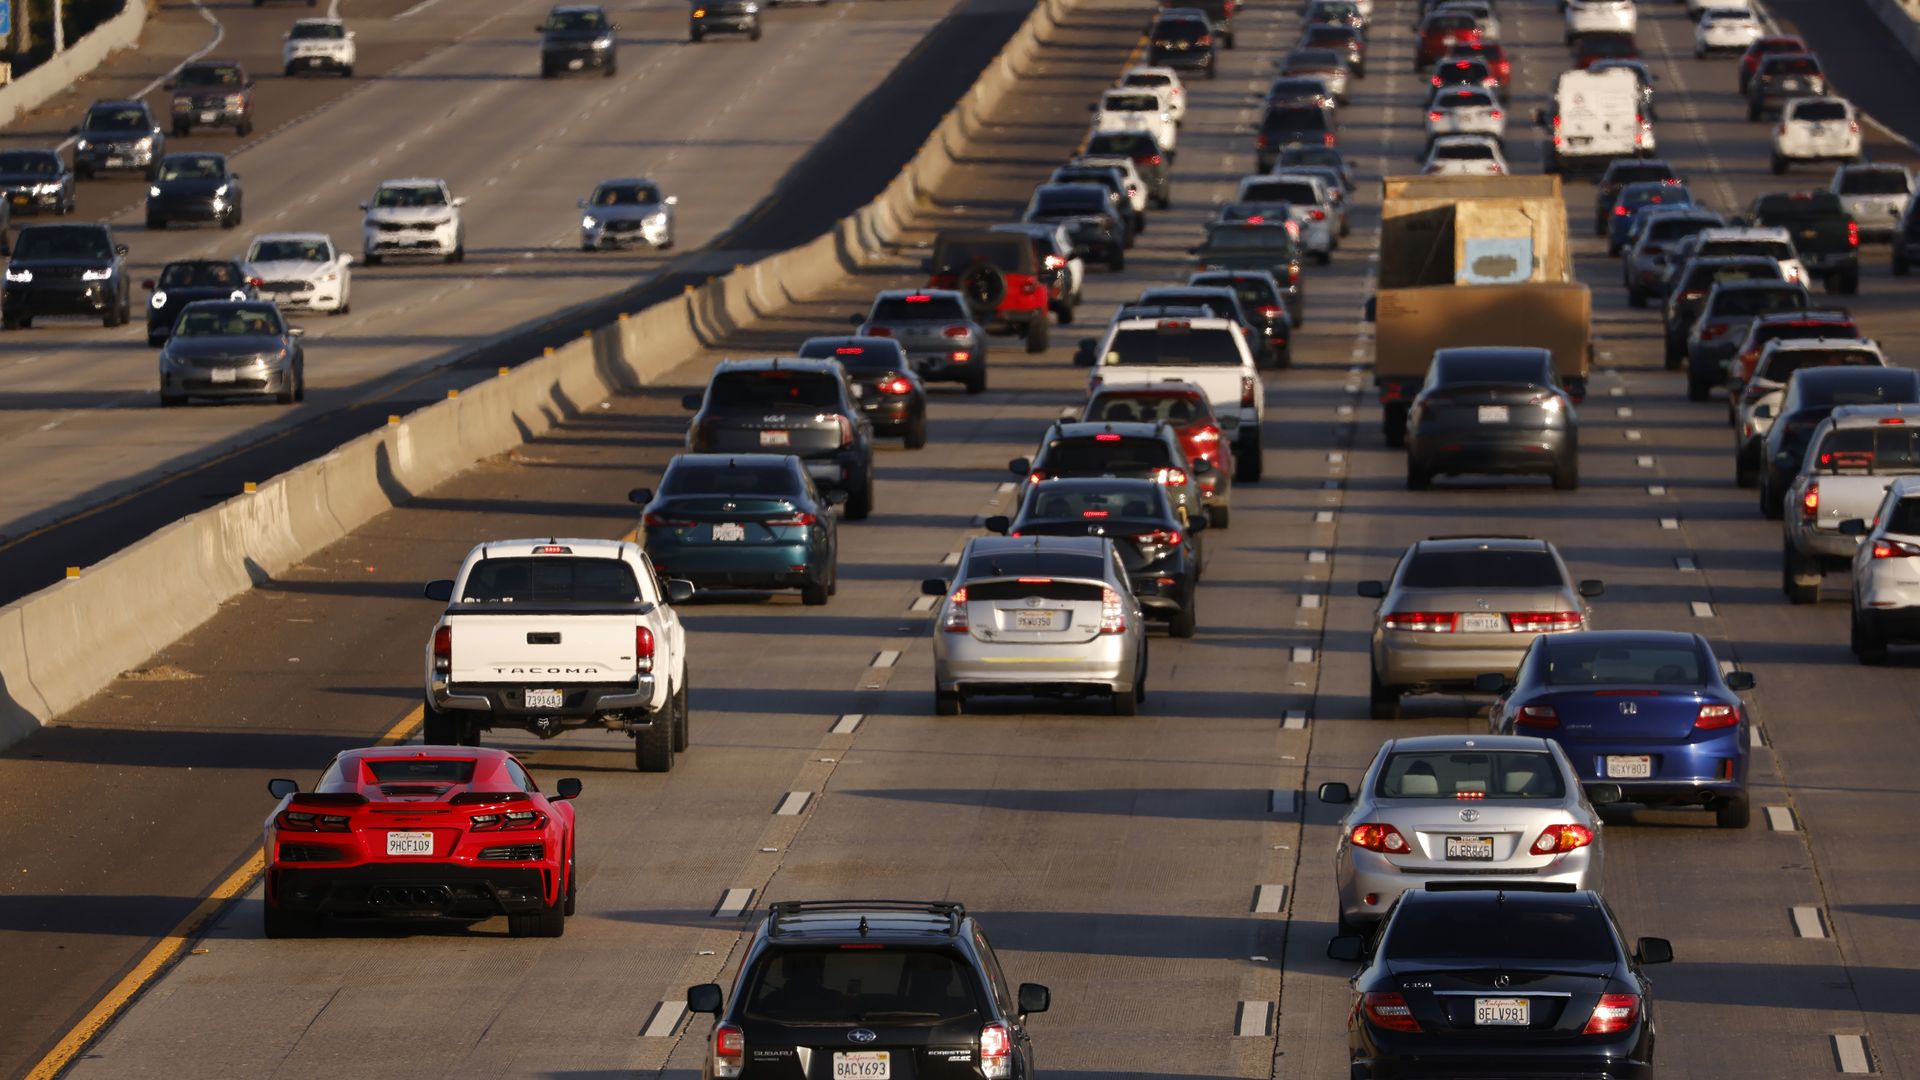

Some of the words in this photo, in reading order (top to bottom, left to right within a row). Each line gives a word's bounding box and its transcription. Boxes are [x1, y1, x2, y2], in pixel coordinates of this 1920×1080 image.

[493, 667, 598, 675] TACOMA
[390, 840, 430, 852] 9HCF109
[1449, 844, 1490, 858] 6LER865
[1485, 999, 1518, 1007] California
[1478, 1007, 1525, 1021] 8ELV981
[845, 1054, 877, 1062] California
[837, 1062, 886, 1076] 8ACY693
